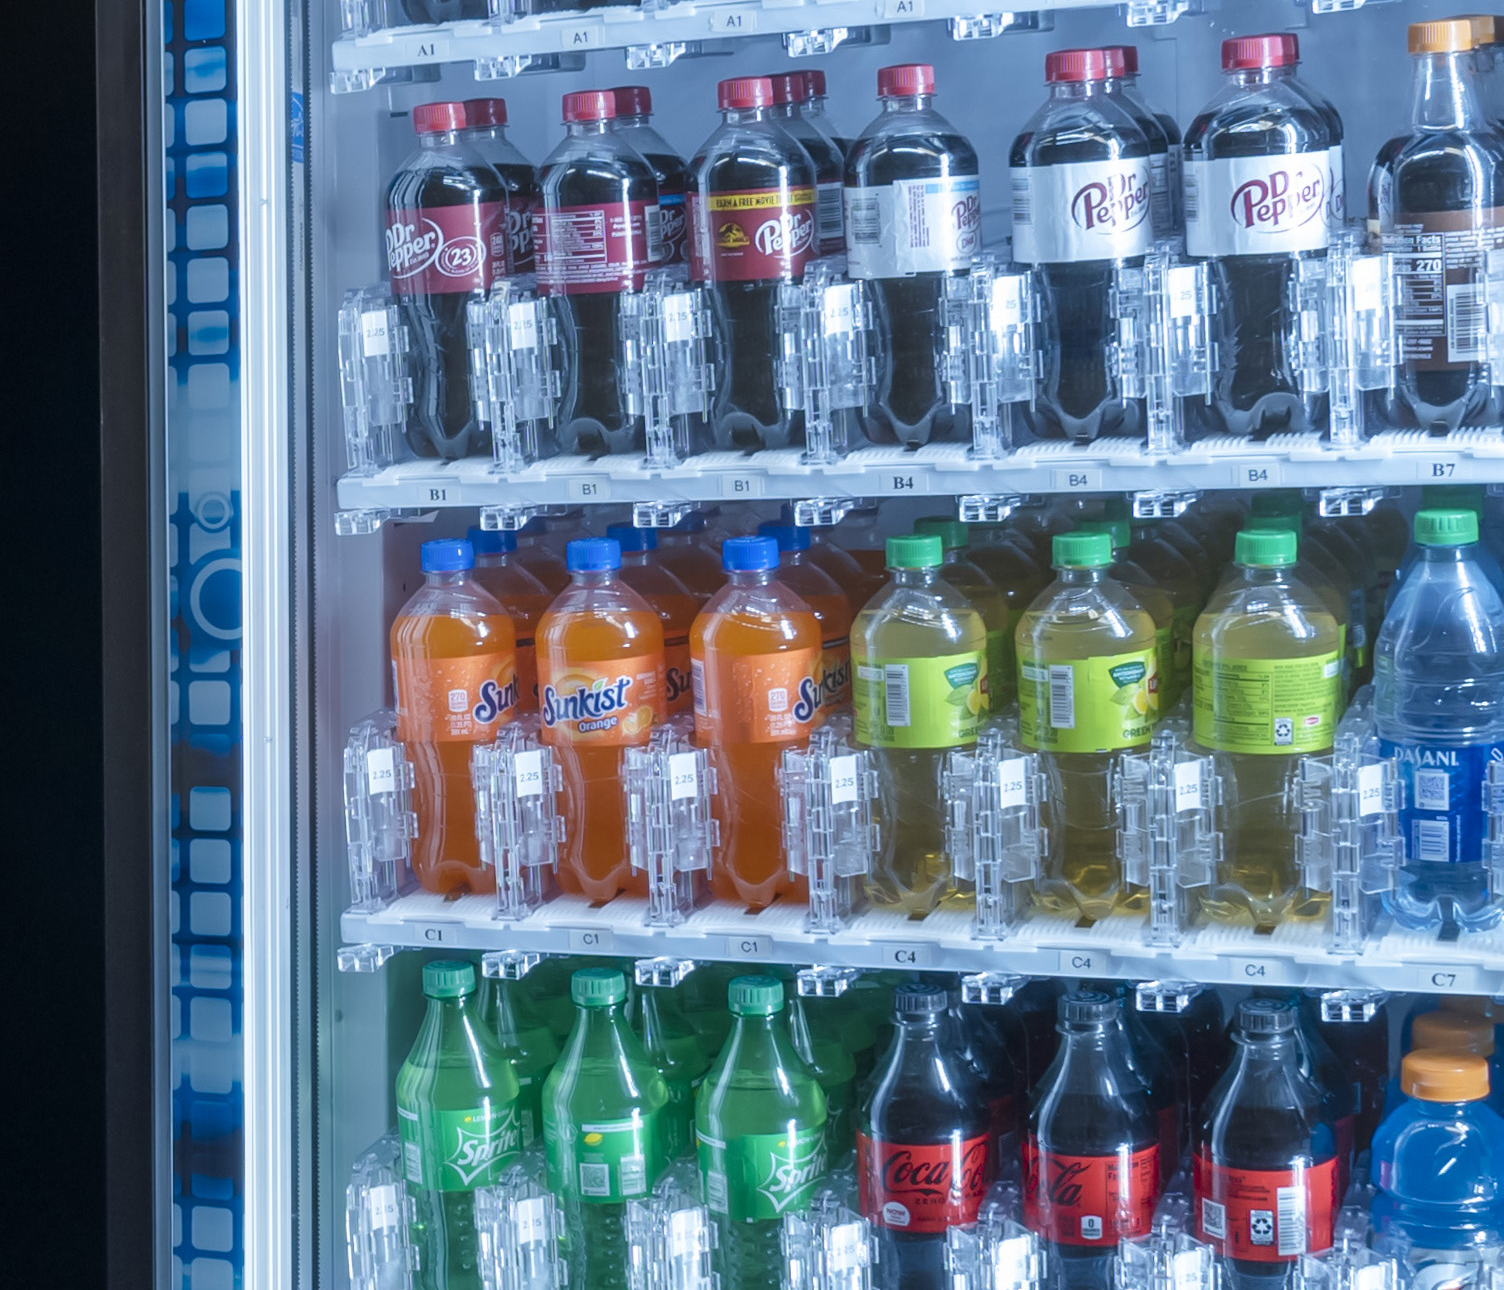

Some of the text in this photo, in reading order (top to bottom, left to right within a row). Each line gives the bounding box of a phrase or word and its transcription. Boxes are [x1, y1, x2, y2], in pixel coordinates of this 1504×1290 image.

[417, 42, 436, 58] A1
[450, 248, 472, 264] 23
[892, 476, 914, 490] B4
[541, 675, 632, 728] Sunkist
[578, 715, 618, 733] Orange
[1394, 746, 1459, 767] DASANI
[519, 770, 540, 783] 2.25
[894, 949, 916, 964] C4
[1431, 972, 1457, 987] C7
[456, 1127, 517, 1169] Sprite
